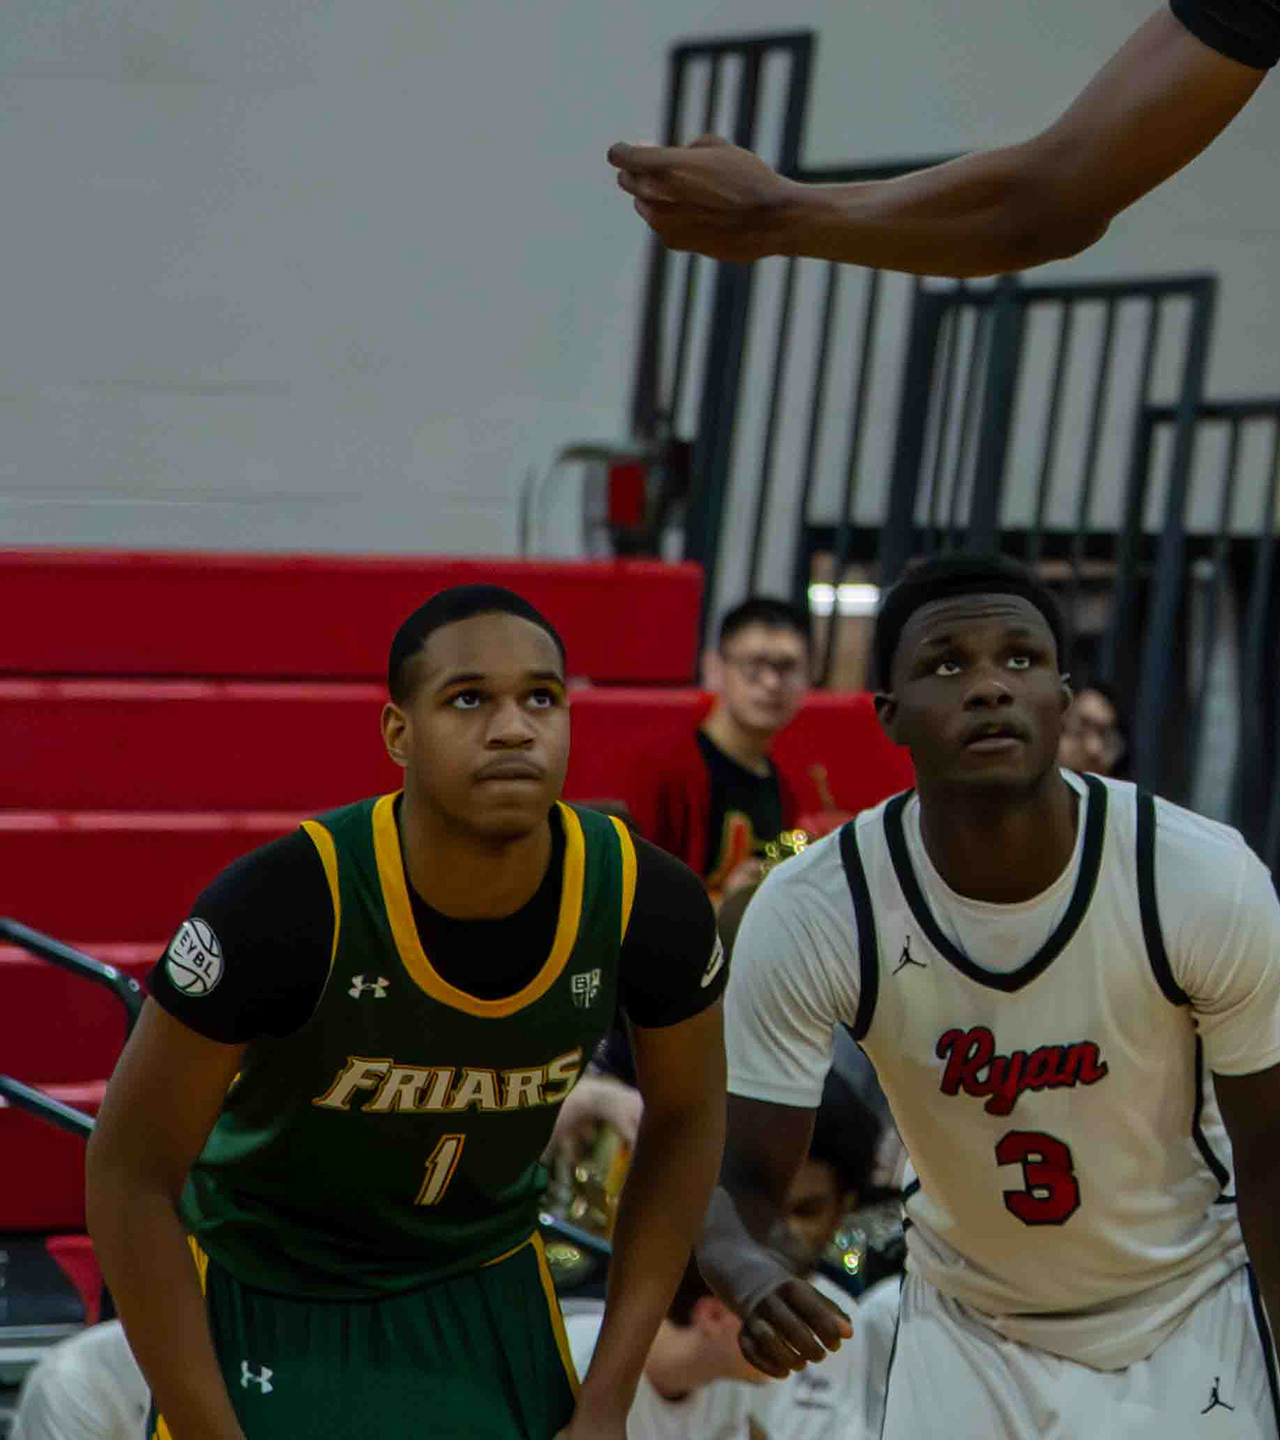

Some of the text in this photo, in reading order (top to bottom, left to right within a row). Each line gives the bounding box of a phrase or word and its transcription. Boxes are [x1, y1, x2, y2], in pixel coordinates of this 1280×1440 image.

[179, 929, 213, 980] EYBL
[311, 1046, 583, 1115] FRIARS
[935, 1026, 1110, 1117] Ryan
[413, 1133, 467, 1206] 1
[995, 1129, 1081, 1227] 3
